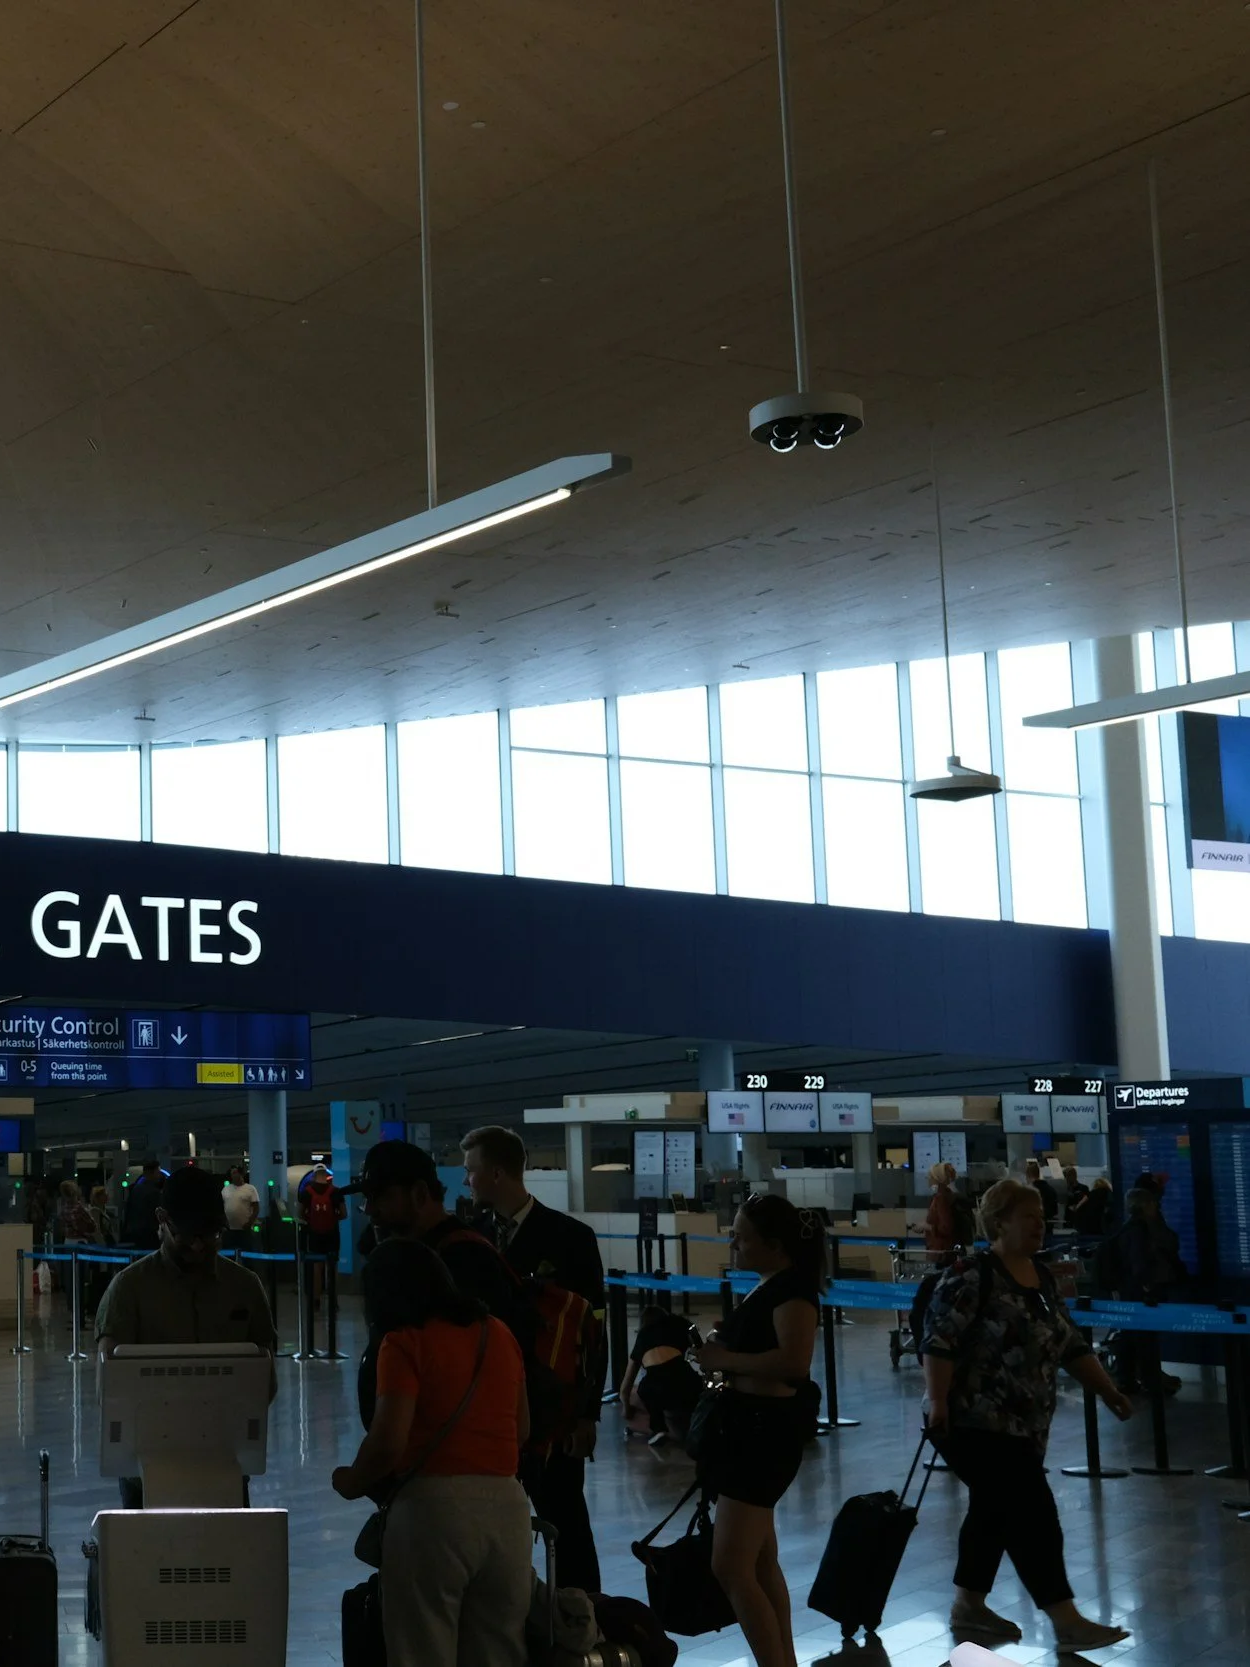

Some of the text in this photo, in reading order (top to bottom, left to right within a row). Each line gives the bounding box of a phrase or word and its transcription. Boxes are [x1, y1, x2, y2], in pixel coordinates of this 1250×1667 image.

[1201, 851, 1244, 862] FINNAIR
[30, 890, 263, 966] GATES
[51, 1016, 119, 1036] Control
[43, 1038, 125, 1050] Säkerhetskontroll
[20, 1060, 37, 1073] 0-5
[50, 1062, 103, 1073] Queuing time
[51, 1072, 107, 1082] from this point
[207, 1070, 235, 1078] Assisted
[746, 1075, 768, 1089] 230
[804, 1076, 825, 1090] 229
[1034, 1079, 1053, 1093] 228
[1084, 1080, 1103, 1093] 227
[1135, 1086, 1190, 1099] Departures
[769, 1102, 814, 1111] FINNAIR
[1055, 1105, 1095, 1113] FINNAIR
